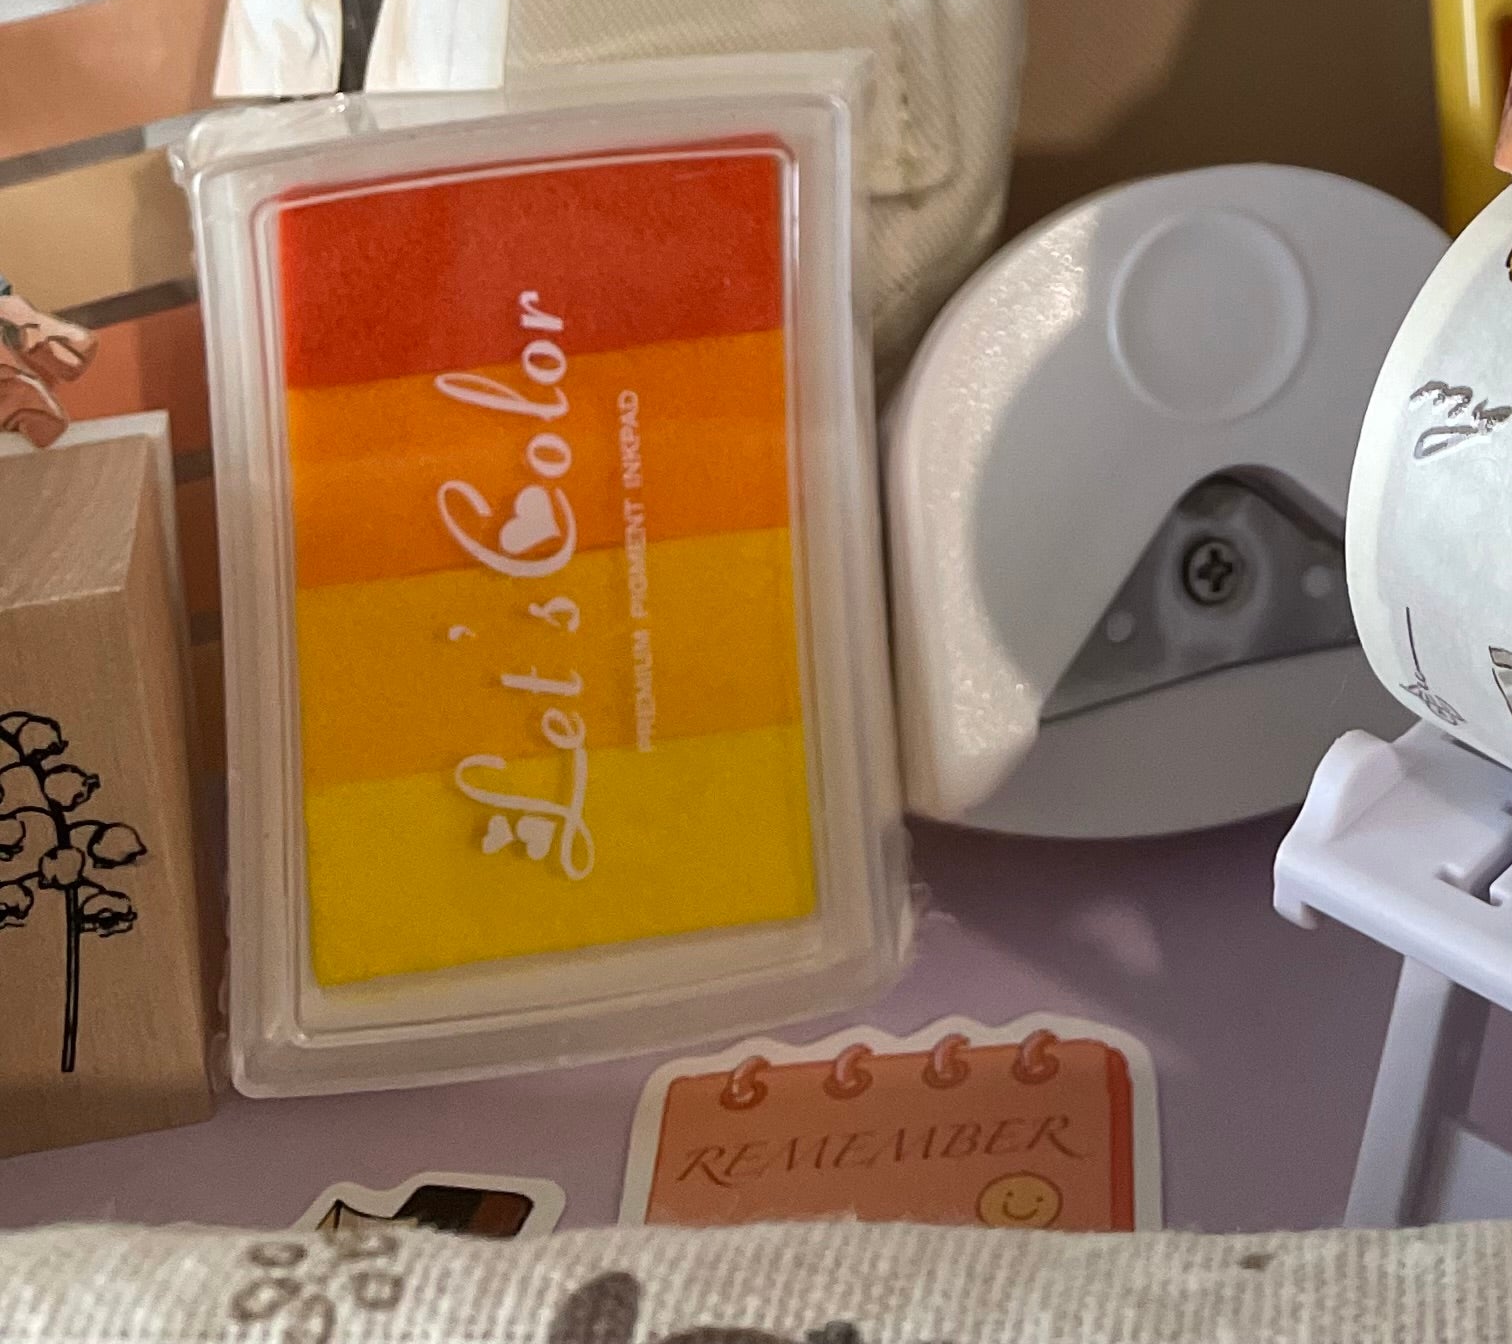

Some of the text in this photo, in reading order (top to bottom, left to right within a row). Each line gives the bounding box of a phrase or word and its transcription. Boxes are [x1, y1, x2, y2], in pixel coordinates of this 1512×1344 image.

[1408, 380, 1512, 459] my
[434, 290, 596, 881] Let's Color
[618, 390, 656, 752] PREMIUM PIGMENT INKPAD
[675, 1114, 1093, 1189] REMEMBER
